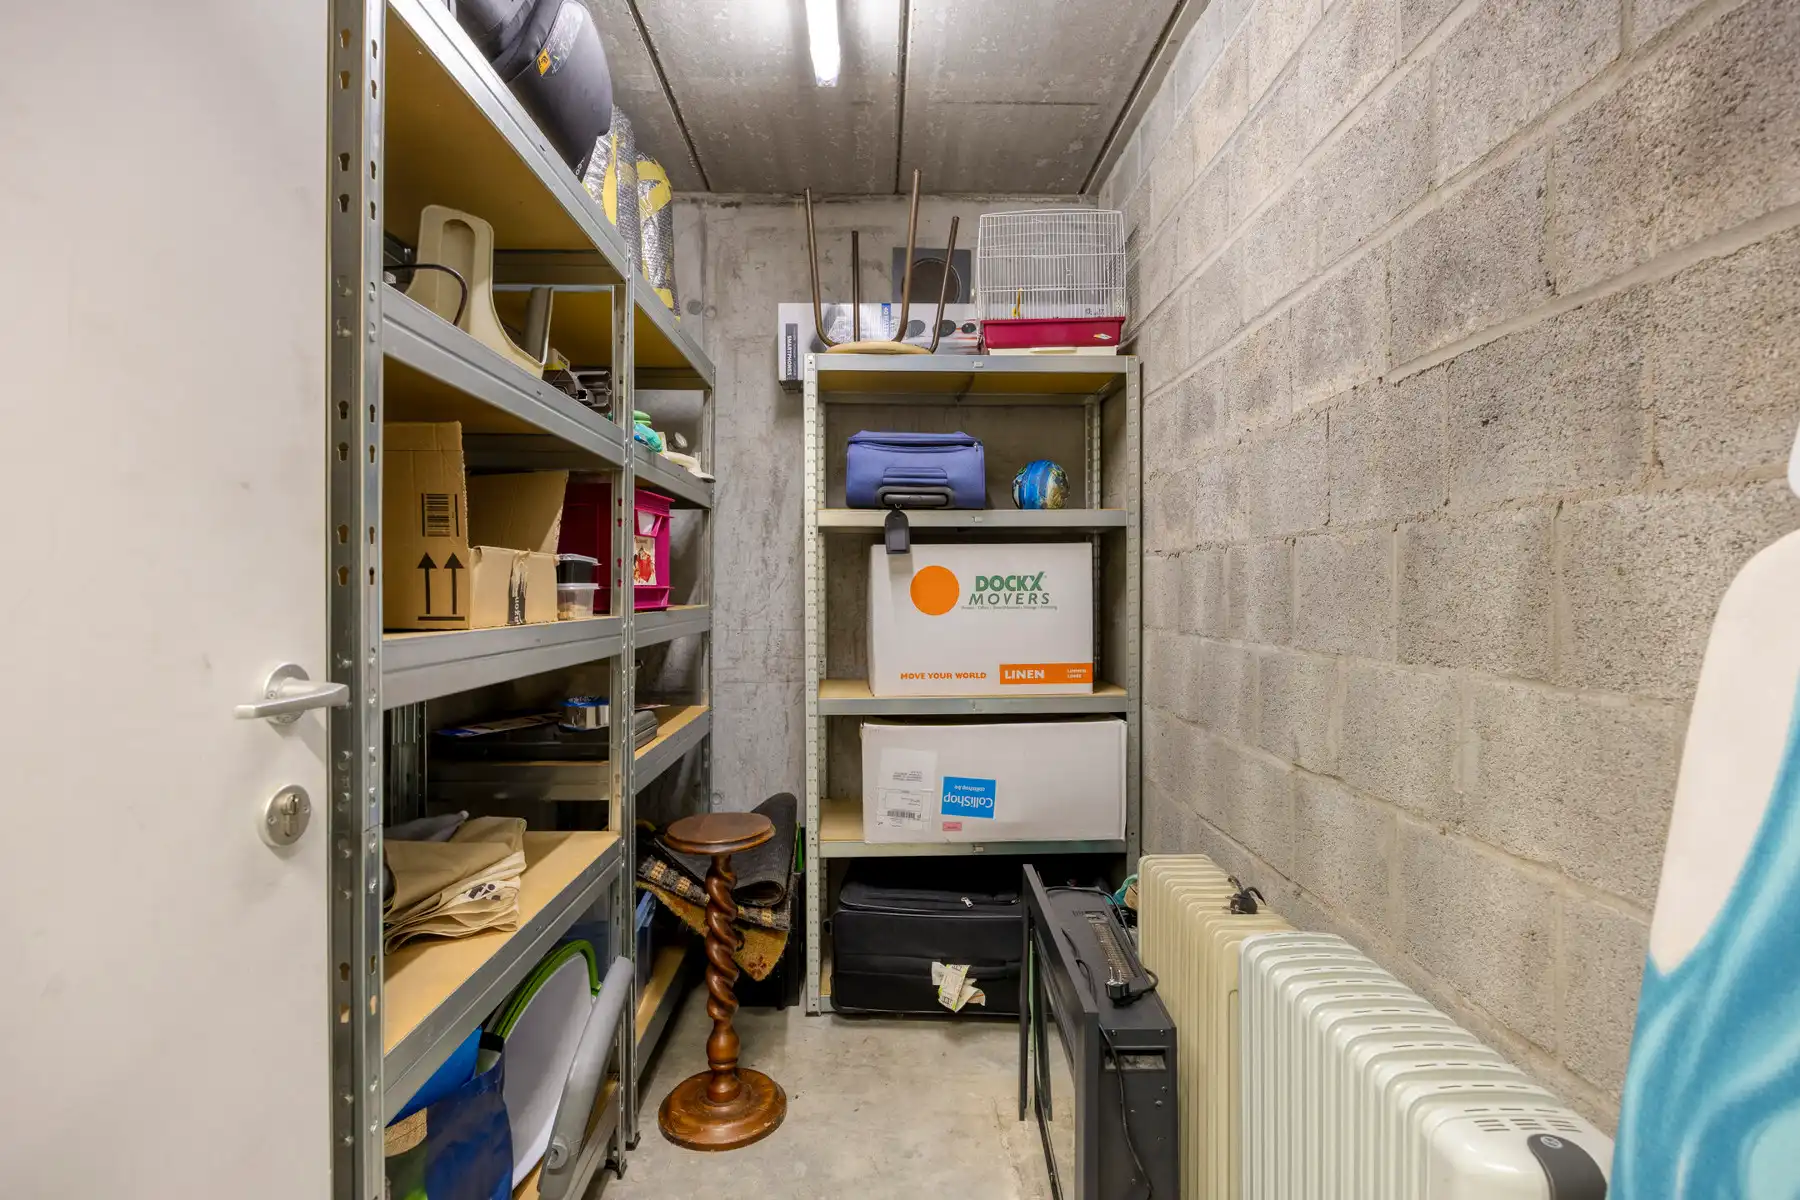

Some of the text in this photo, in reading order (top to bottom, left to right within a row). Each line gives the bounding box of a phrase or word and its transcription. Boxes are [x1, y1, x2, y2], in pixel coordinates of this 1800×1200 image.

[975, 571, 1045, 592] DOCKX
[968, 592, 1050, 605] MOVERS
[1004, 669, 1045, 679] LINEN
[944, 792, 993, 809] ColliShop
